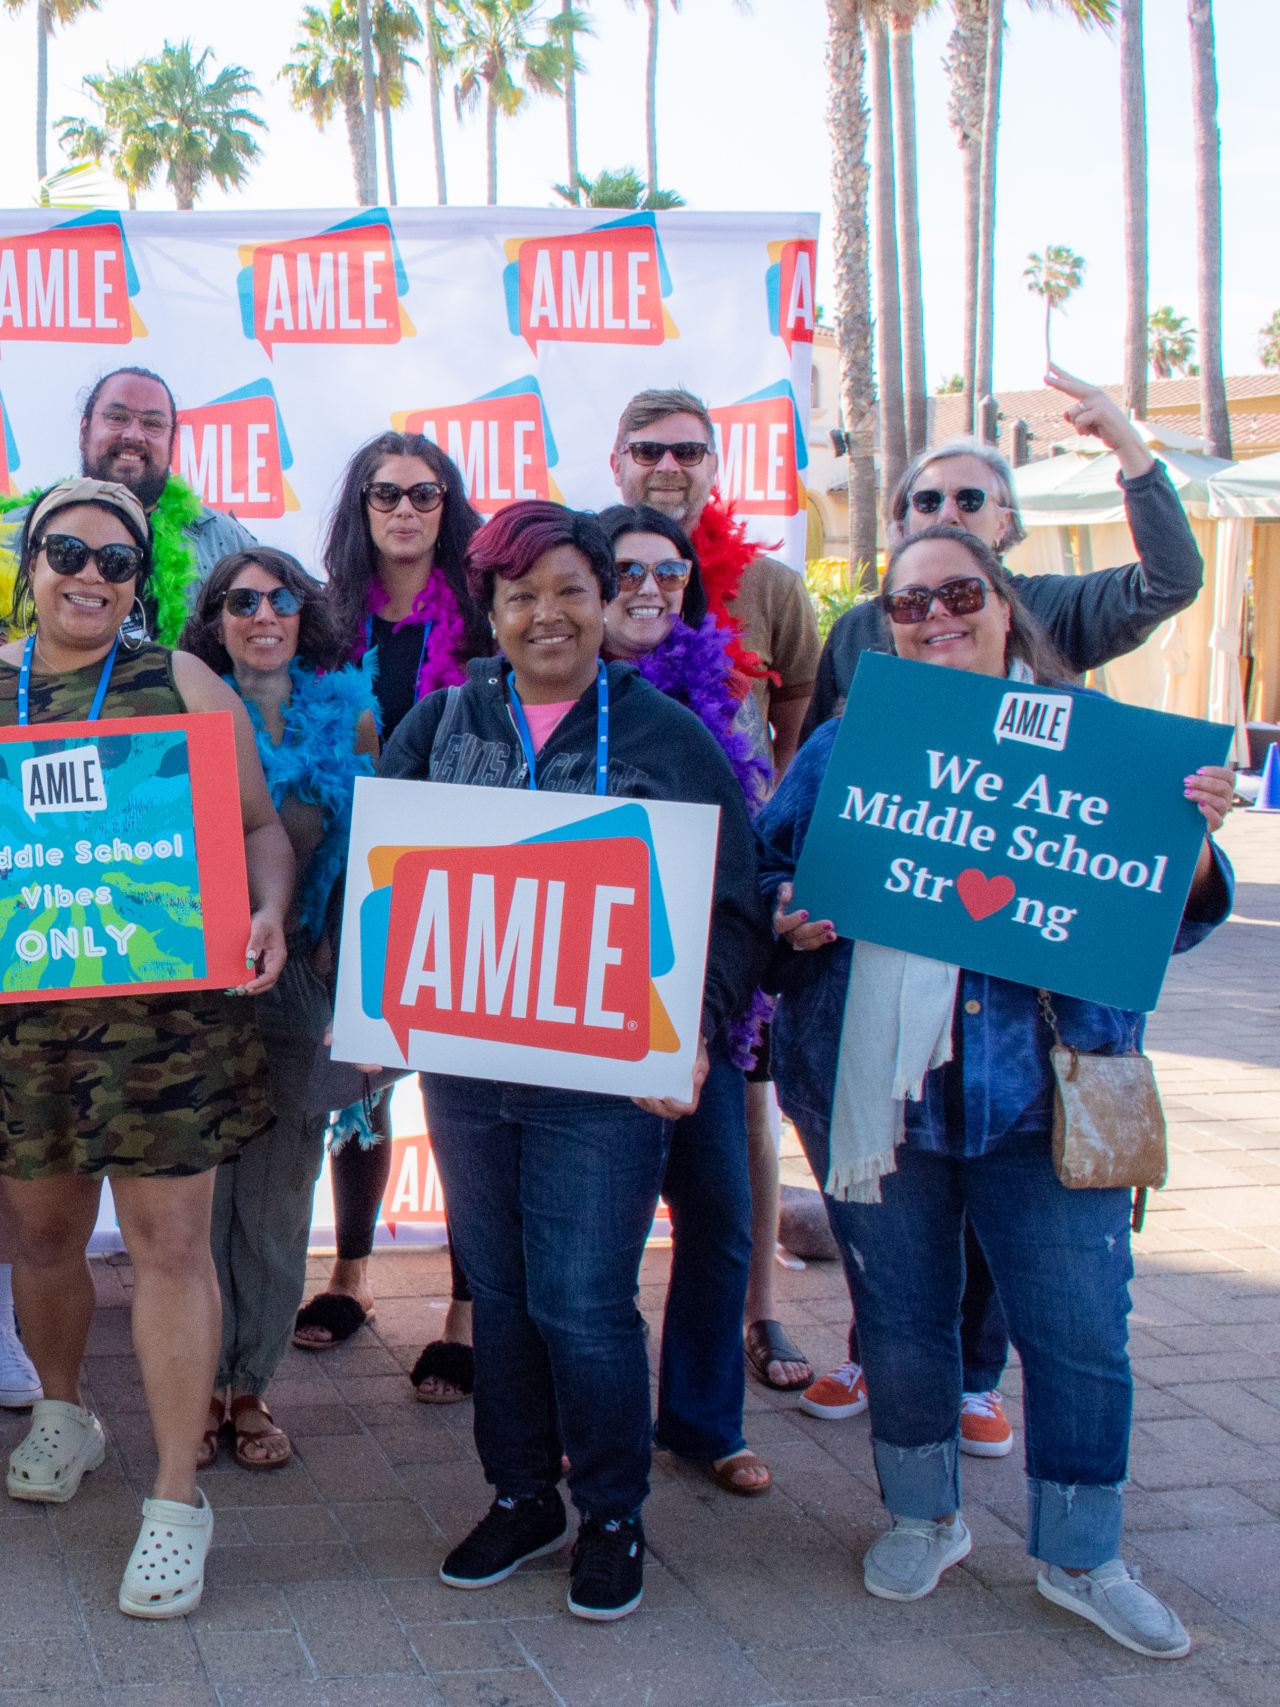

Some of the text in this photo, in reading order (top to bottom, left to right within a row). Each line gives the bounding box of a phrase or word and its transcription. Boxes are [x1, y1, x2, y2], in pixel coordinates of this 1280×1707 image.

[264, 251, 387, 331] AMLE
[530, 249, 652, 329] AMLE
[786, 251, 814, 330] A
[170, 424, 270, 503] MLE
[713, 423, 788, 501] MLE
[1000, 697, 1067, 743] AMLE
[29, 760, 99, 807] AMLE
[926, 749, 1109, 826] We Are
[74, 833, 184, 865] School
[839, 786, 1169, 894] Middle School
[21, 884, 113, 910] Vibes
[15, 923, 137, 962] ONLY
[399, 868, 636, 1030] AMLE
